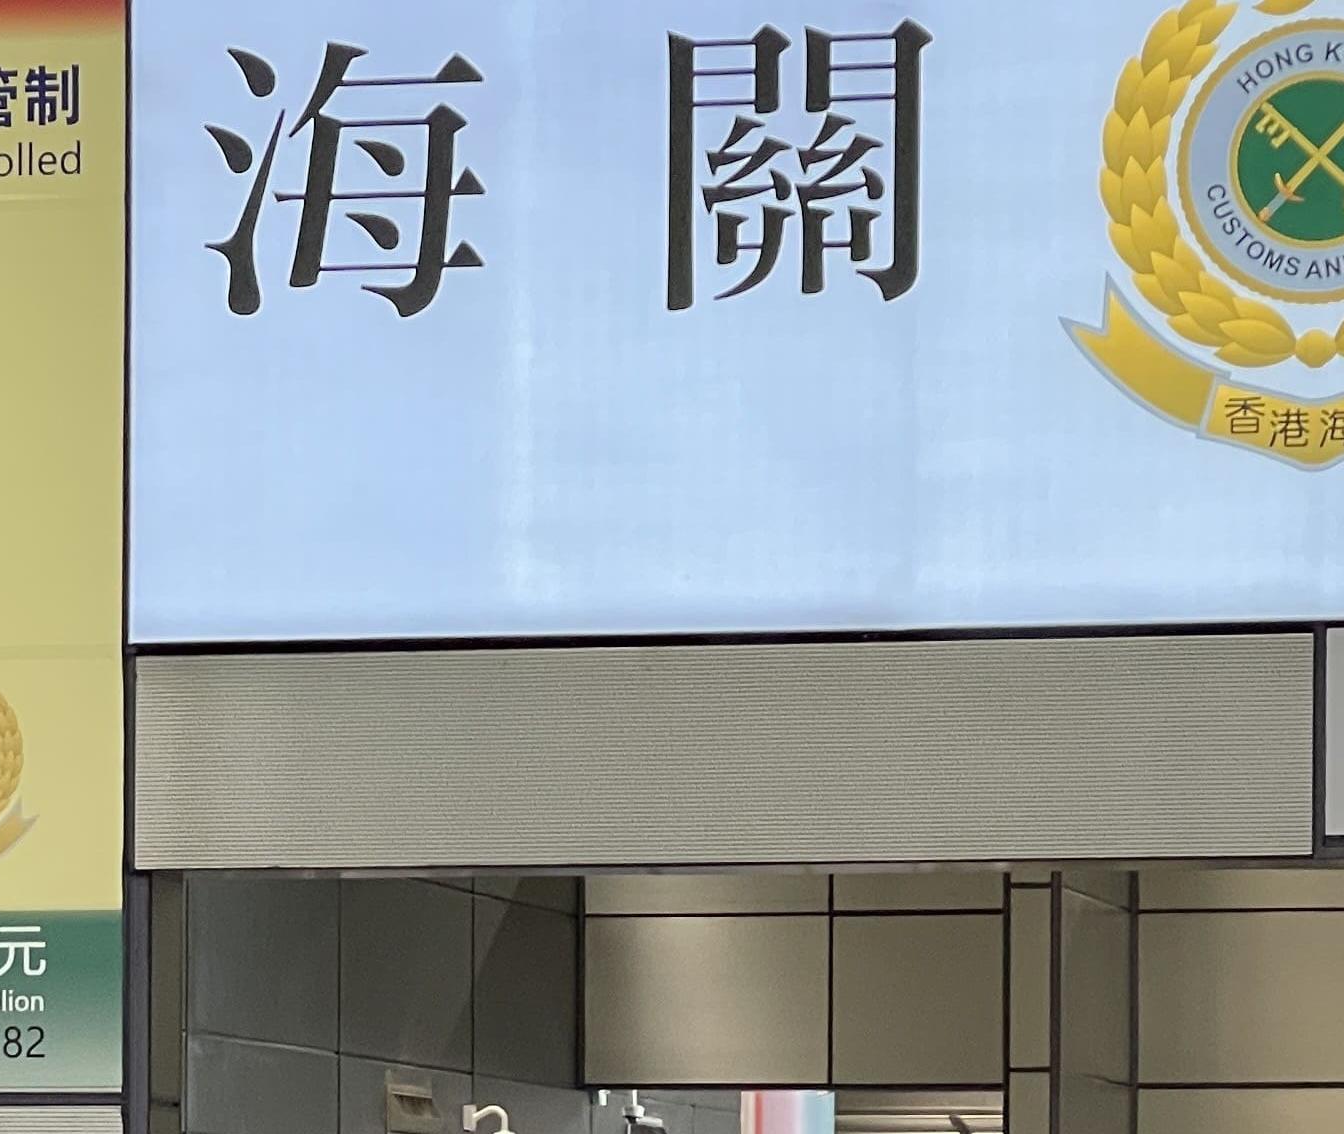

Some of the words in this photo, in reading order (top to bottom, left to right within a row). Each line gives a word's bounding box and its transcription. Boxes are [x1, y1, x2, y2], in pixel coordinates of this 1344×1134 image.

[1236, 42, 1313, 94] HONG
[203, 18, 933, 318] 海關
[1206, 182, 1300, 277] CUSTOMS
